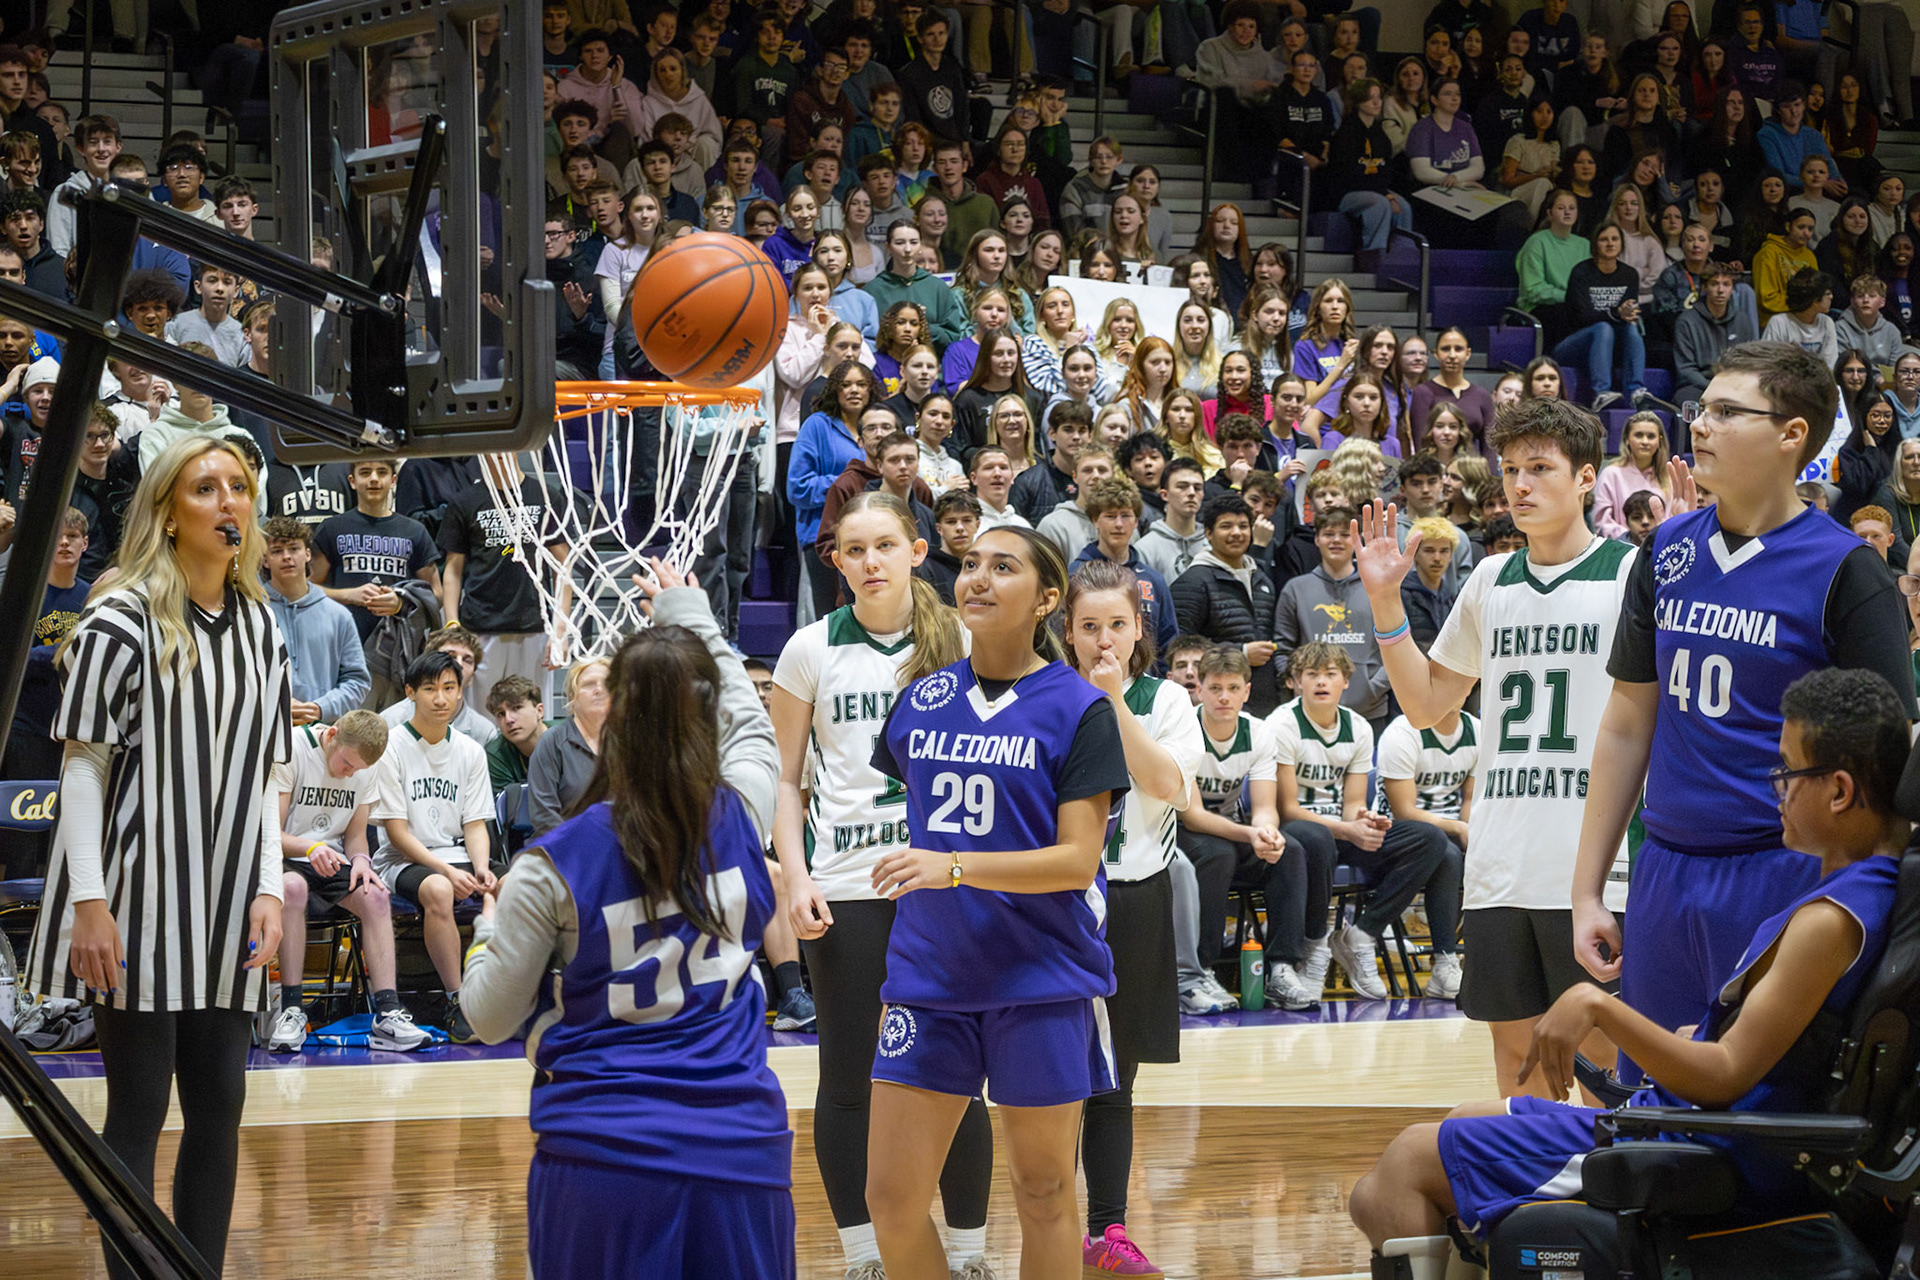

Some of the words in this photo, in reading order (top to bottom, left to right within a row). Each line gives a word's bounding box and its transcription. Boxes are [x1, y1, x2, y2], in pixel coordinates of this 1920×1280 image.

[283, 489, 345, 516] GVSU
[336, 534, 413, 559] CALEDONIA
[344, 556, 407, 576] TOUGH
[1653, 598, 1777, 648] CALEDONIA
[1491, 623, 1600, 659] JENISON
[1668, 648, 1733, 718] 40
[832, 691, 894, 724] JENI
[1498, 669, 1577, 754] 21
[908, 729, 1036, 770] CALEDONIA
[1296, 762, 1344, 780] JENISO
[10, 788, 57, 820] Cal
[297, 786, 356, 810] JENISON
[411, 777, 458, 803] JENISON
[927, 772, 995, 836] 29
[833, 818, 911, 853] WILDC
[602, 866, 754, 1025] 54
[1537, 1251, 1580, 1261] COMFORT
